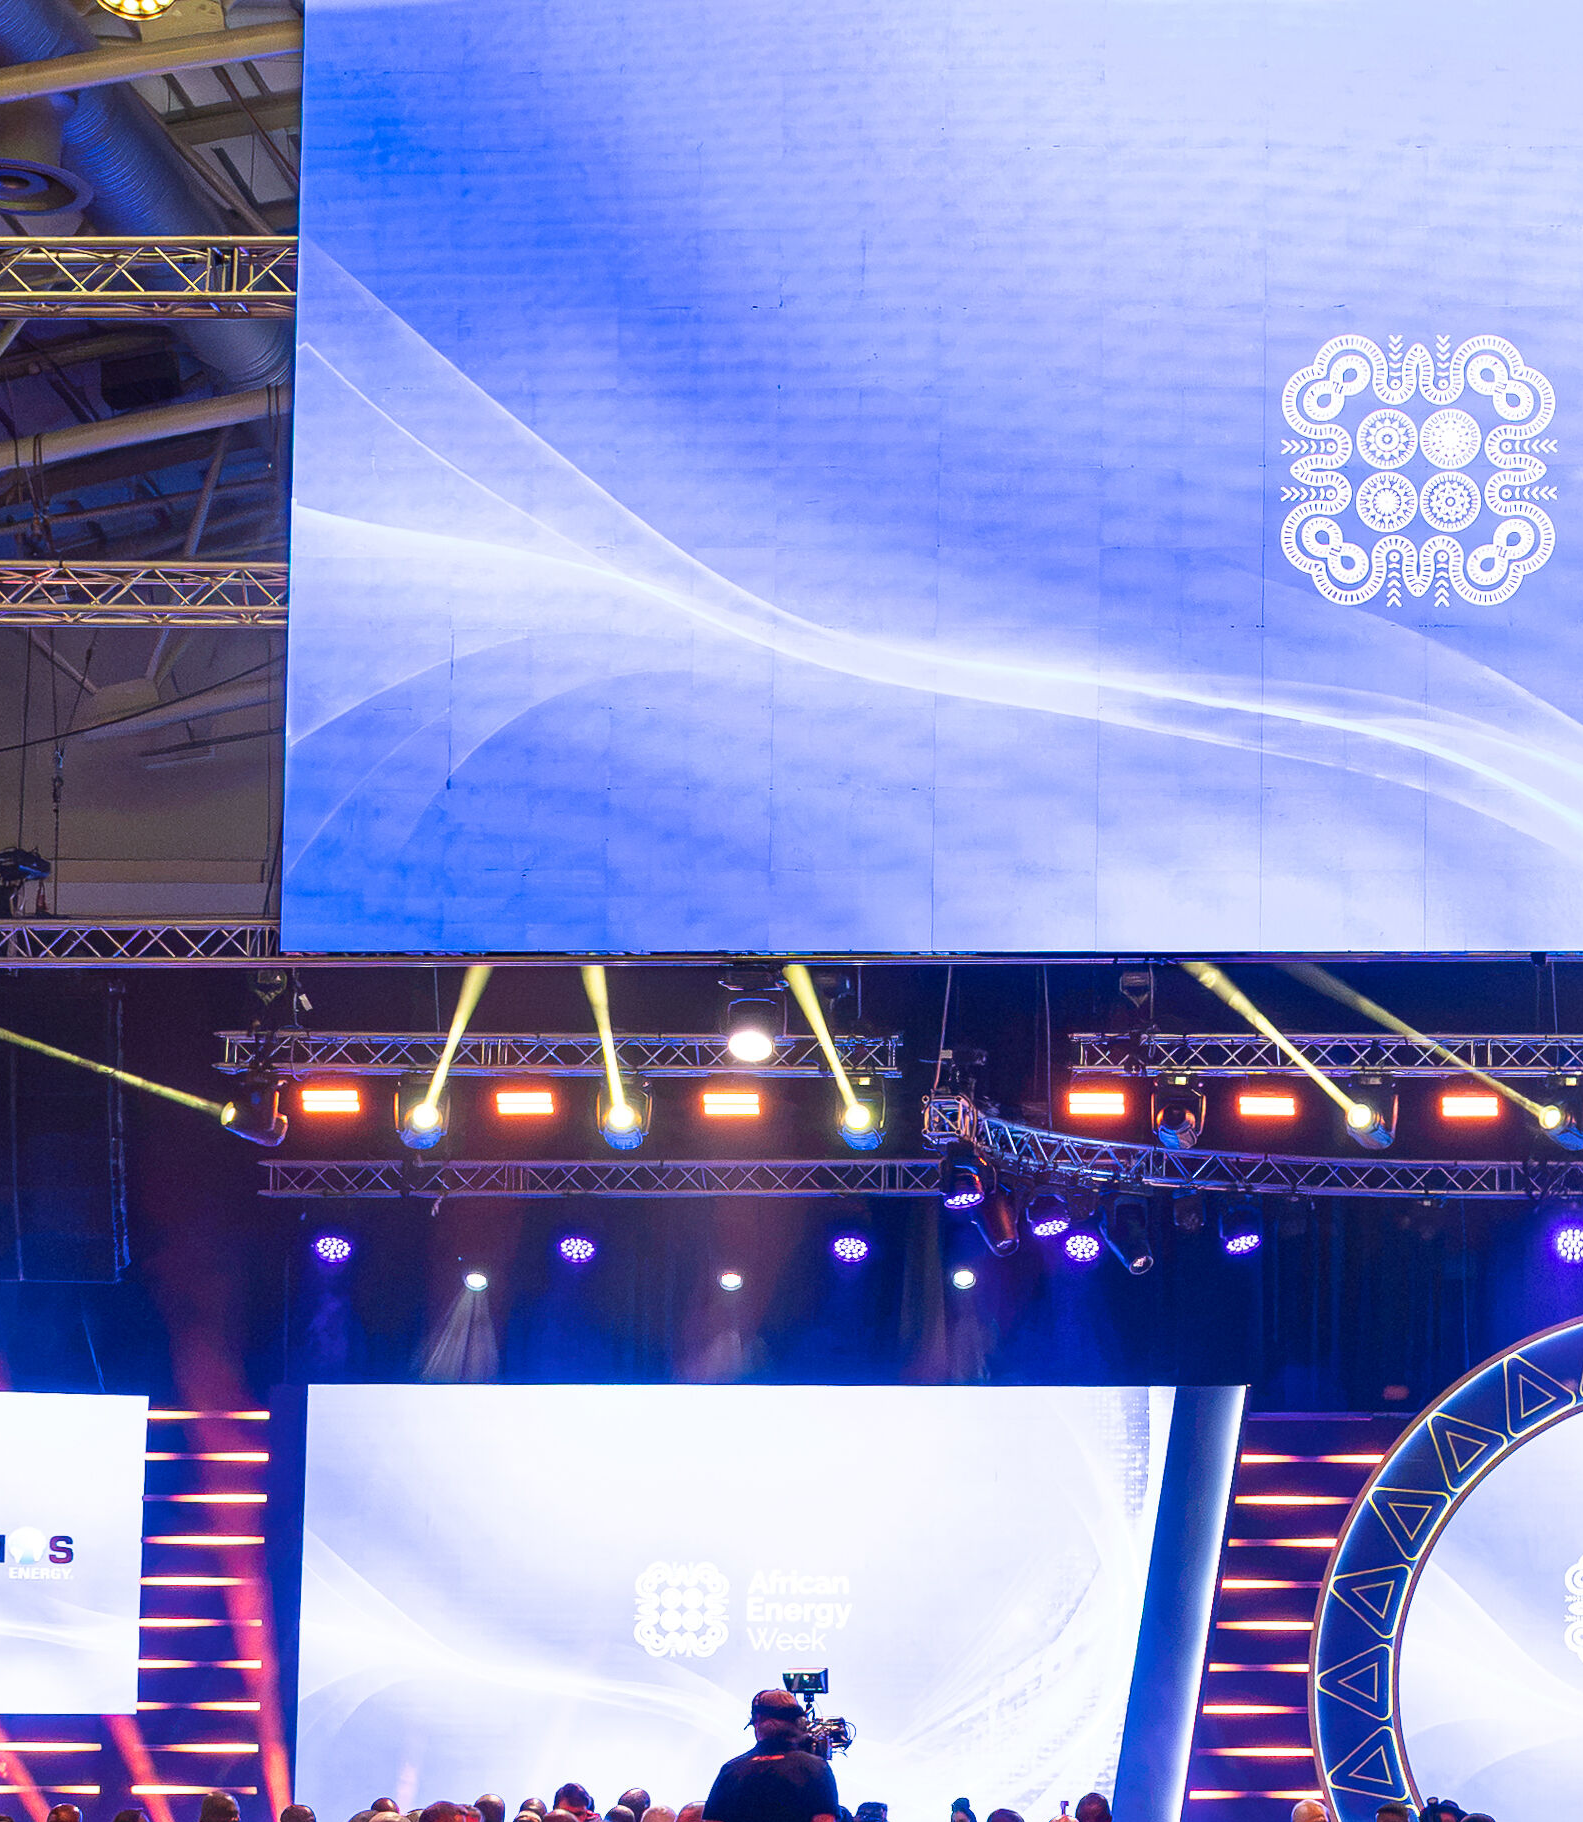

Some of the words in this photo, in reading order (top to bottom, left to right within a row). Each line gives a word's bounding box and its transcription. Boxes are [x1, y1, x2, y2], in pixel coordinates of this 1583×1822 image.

[747, 1569, 850, 1596] African
[745, 1596, 853, 1629] Energy
[746, 1627, 827, 1652] Week
